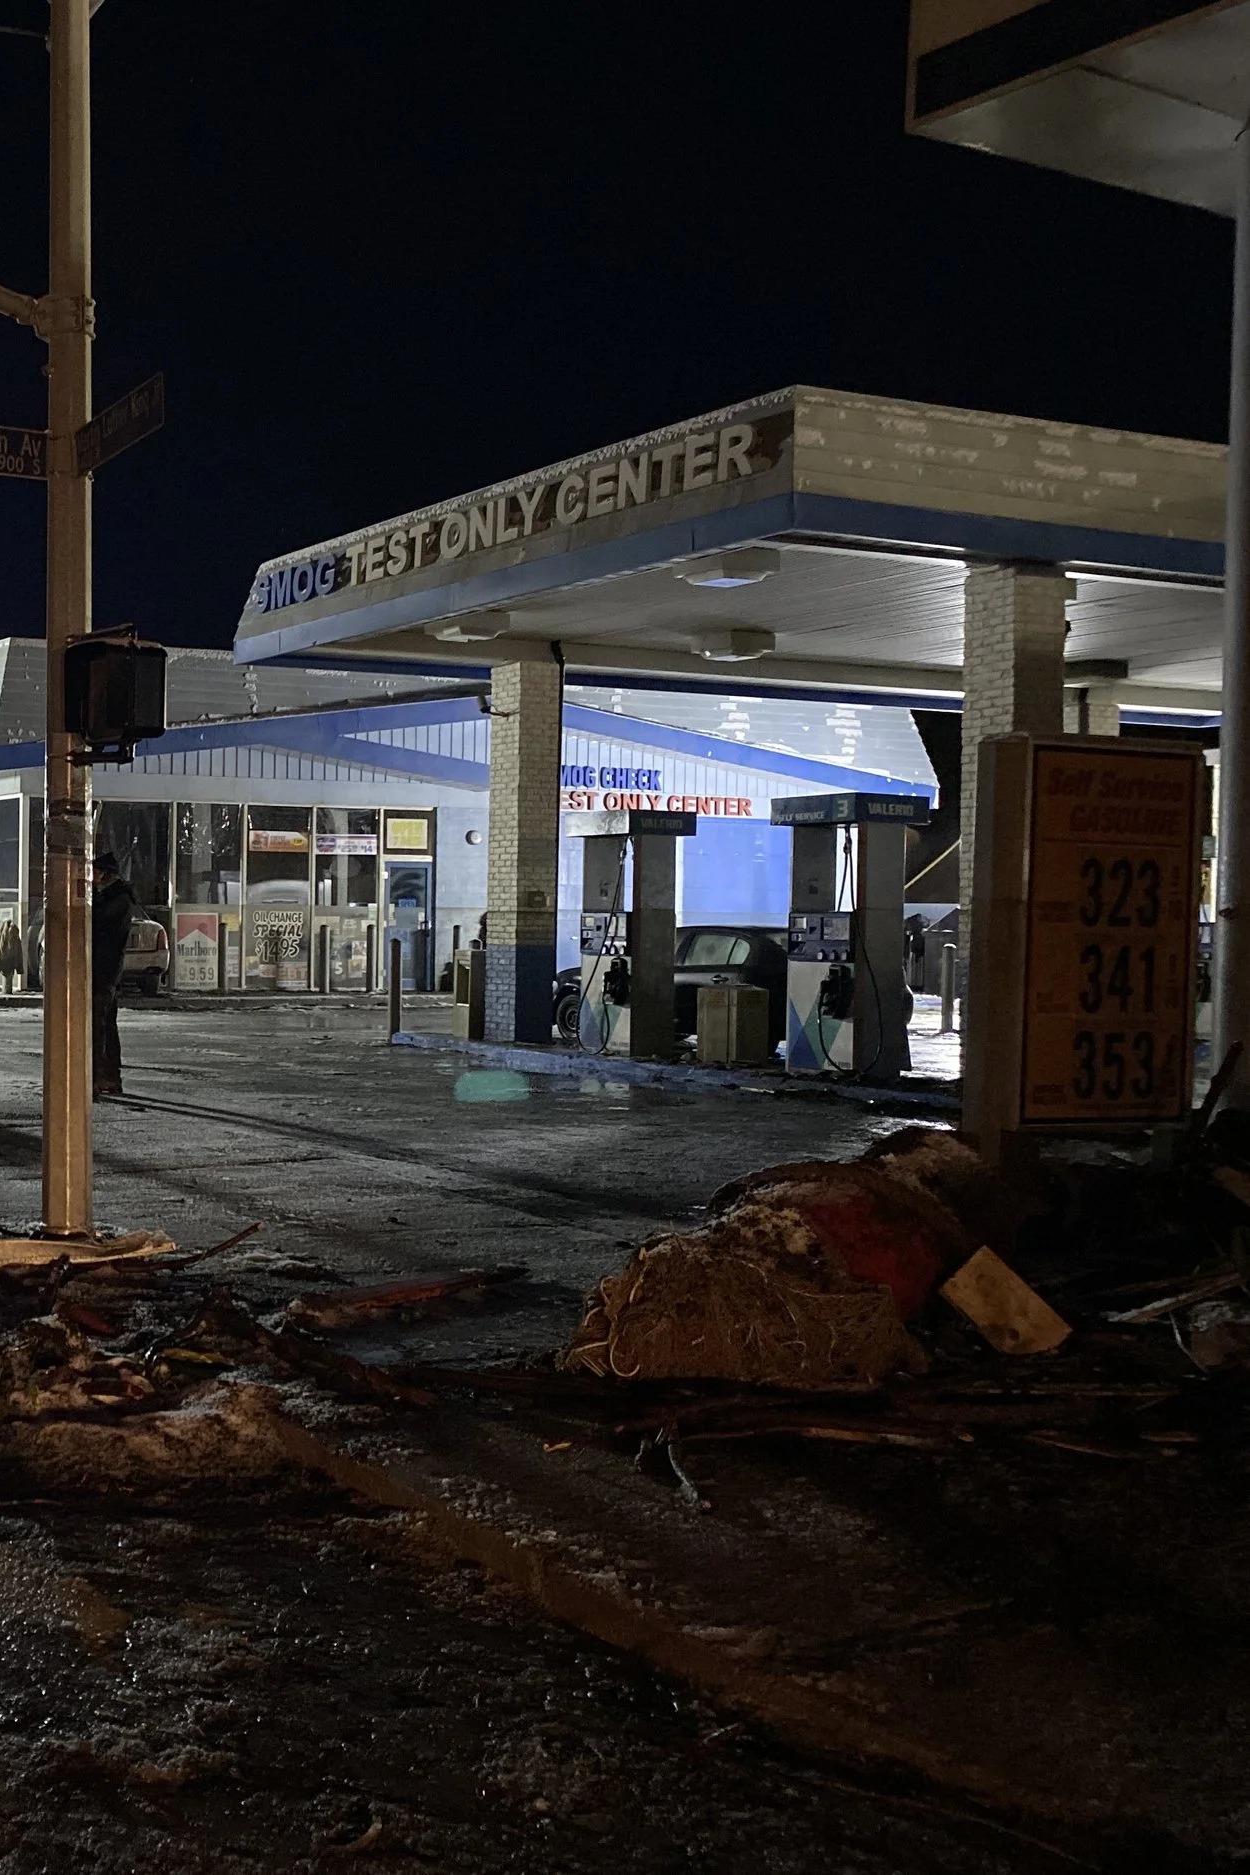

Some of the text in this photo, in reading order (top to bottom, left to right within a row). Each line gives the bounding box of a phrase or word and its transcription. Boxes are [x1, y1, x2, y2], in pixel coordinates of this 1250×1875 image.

[21, 435, 41, 458] Av
[33, 458, 41, 476] S
[255, 423, 754, 613] SMOG TEST ONLY CENTER
[599, 766, 662, 791] CHECK
[603, 792, 663, 811] ONLY
[667, 794, 753, 817] CENTER
[838, 799, 849, 818] 3
[795, 811, 826, 822] SERVICE
[1079, 857, 1160, 928] 323
[253, 911, 303, 923] OIL CHANGE
[253, 923, 303, 938] SPECIAL
[177, 941, 217, 956] Marlboro
[189, 966, 214, 981] 9.59
[1079, 945, 1156, 1013] 341
[1073, 1031, 1154, 1100] 353
